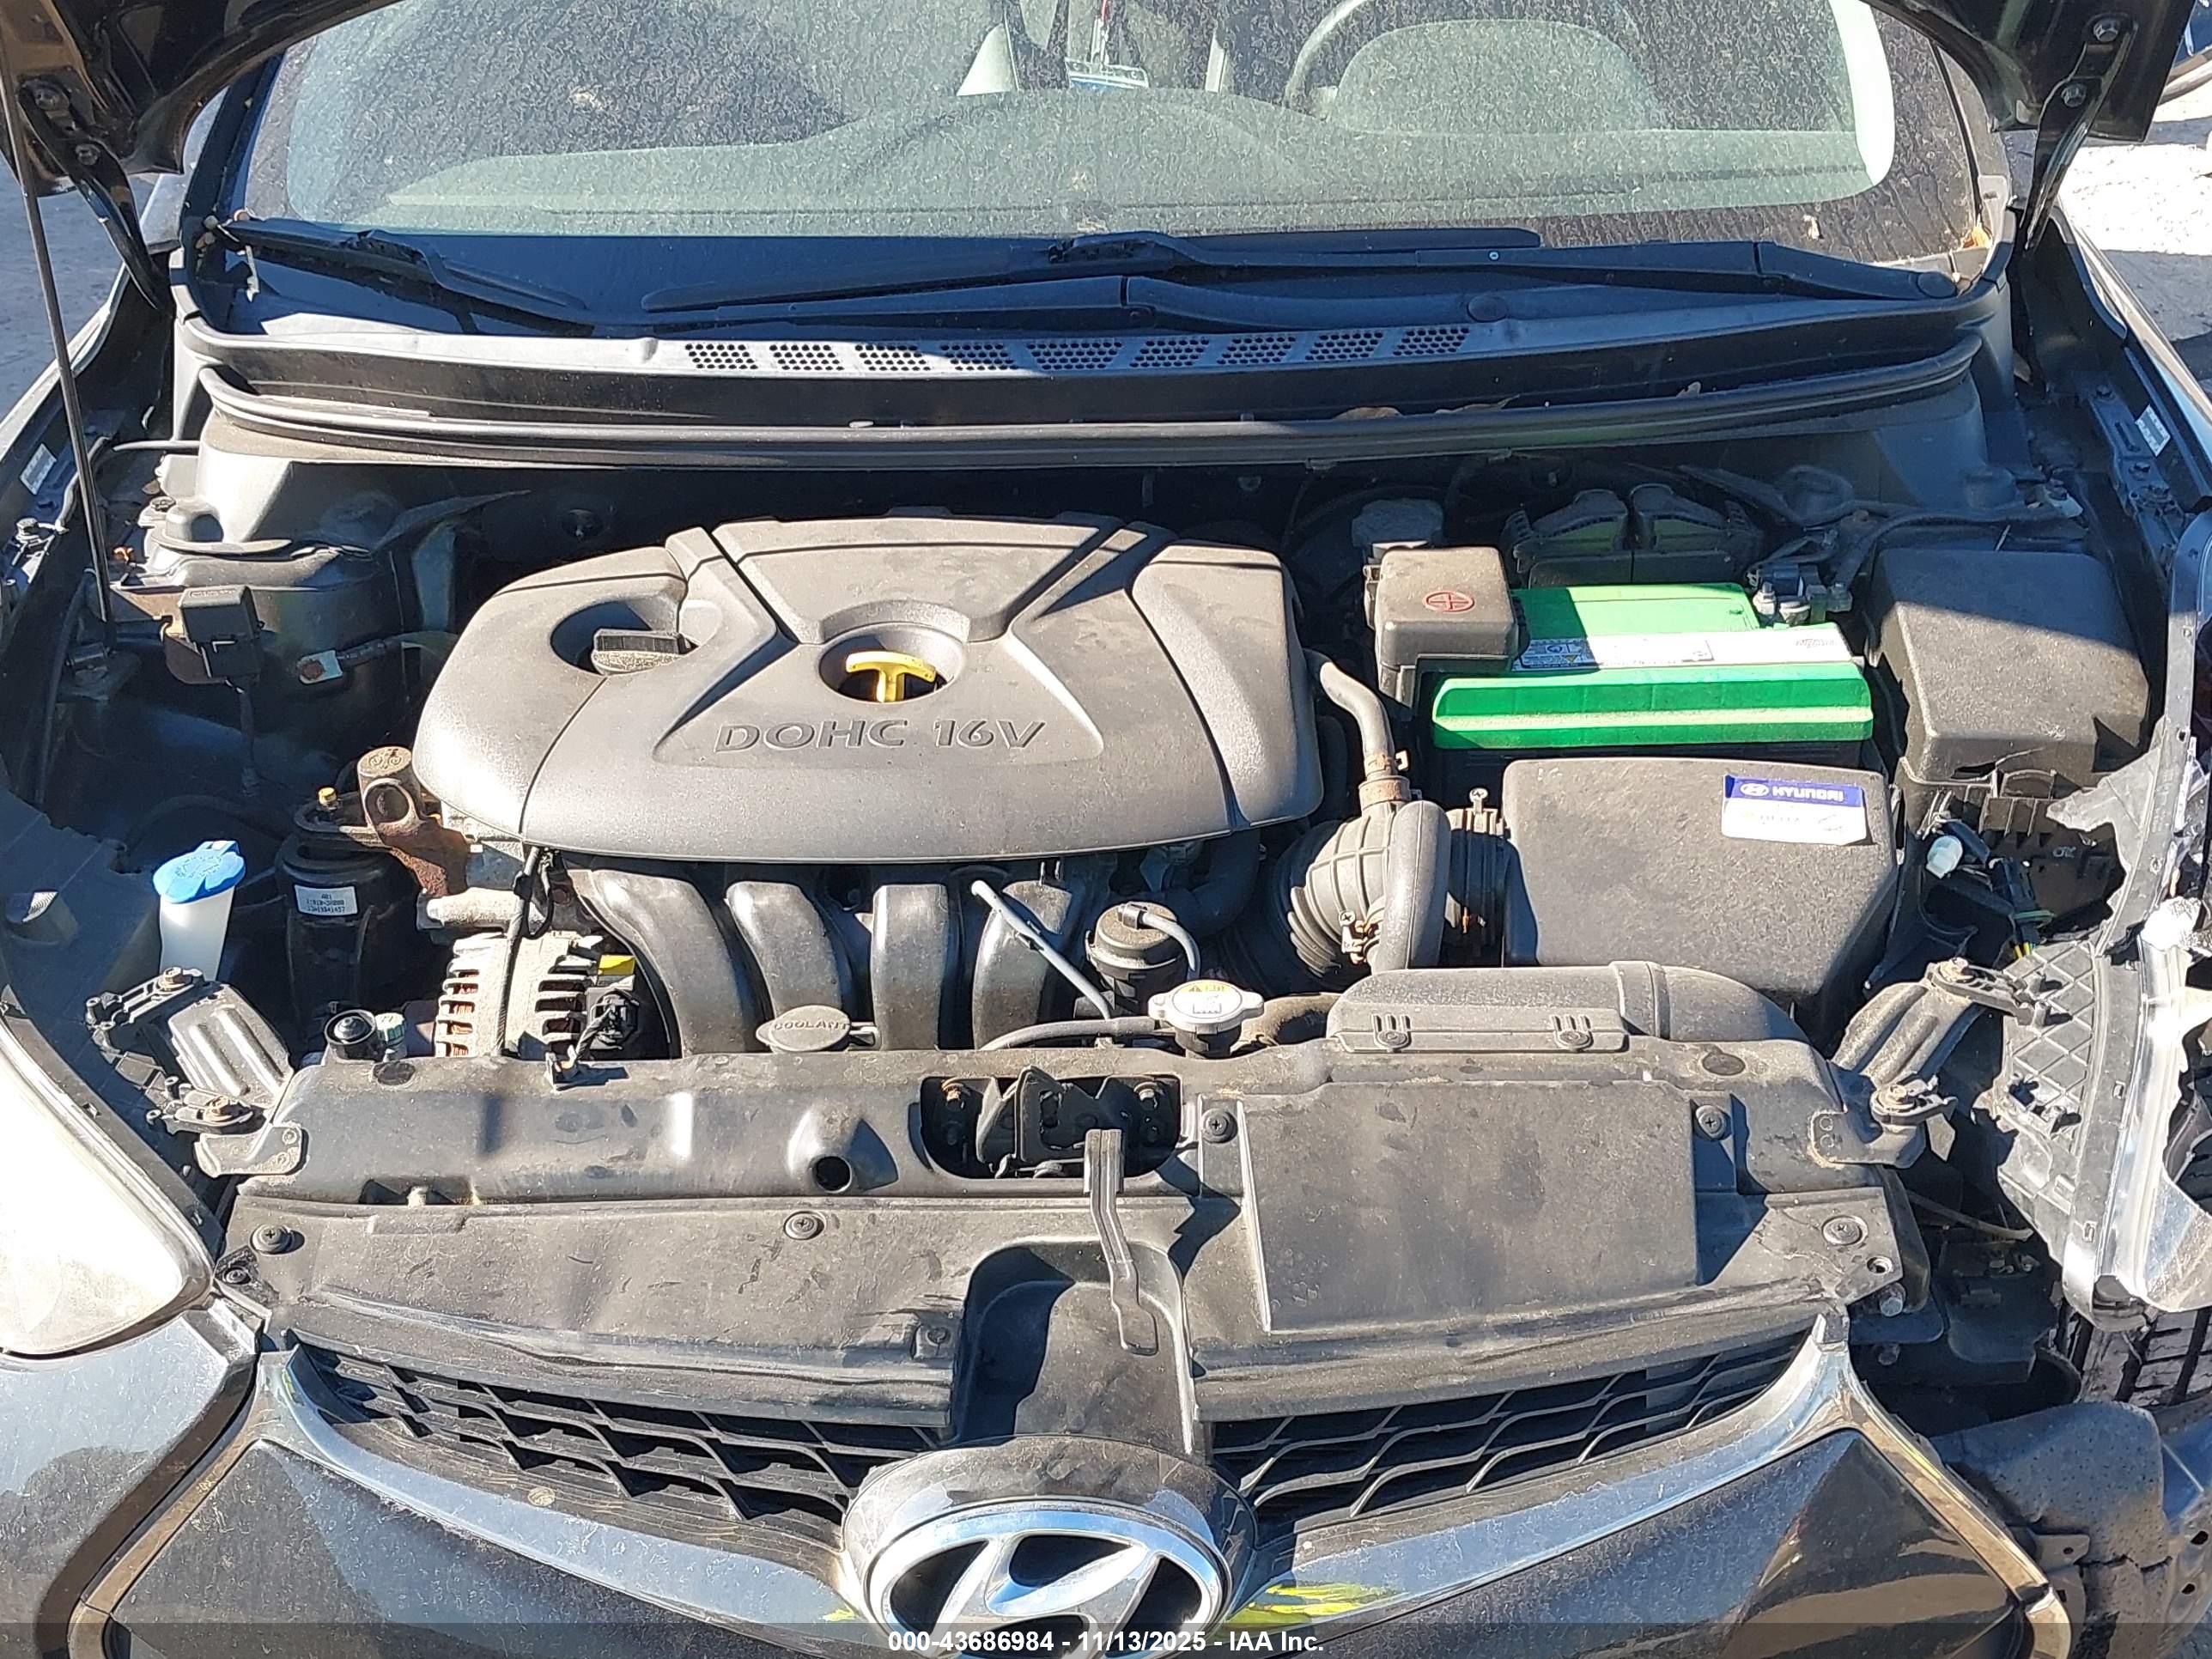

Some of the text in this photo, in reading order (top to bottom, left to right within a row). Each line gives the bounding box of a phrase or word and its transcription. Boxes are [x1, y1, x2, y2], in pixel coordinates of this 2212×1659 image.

[714, 719, 1047, 752] DOHC 16V
[1771, 786, 1844, 802] HYUNDAI
[774, 1018, 848, 1030] COOLANT
